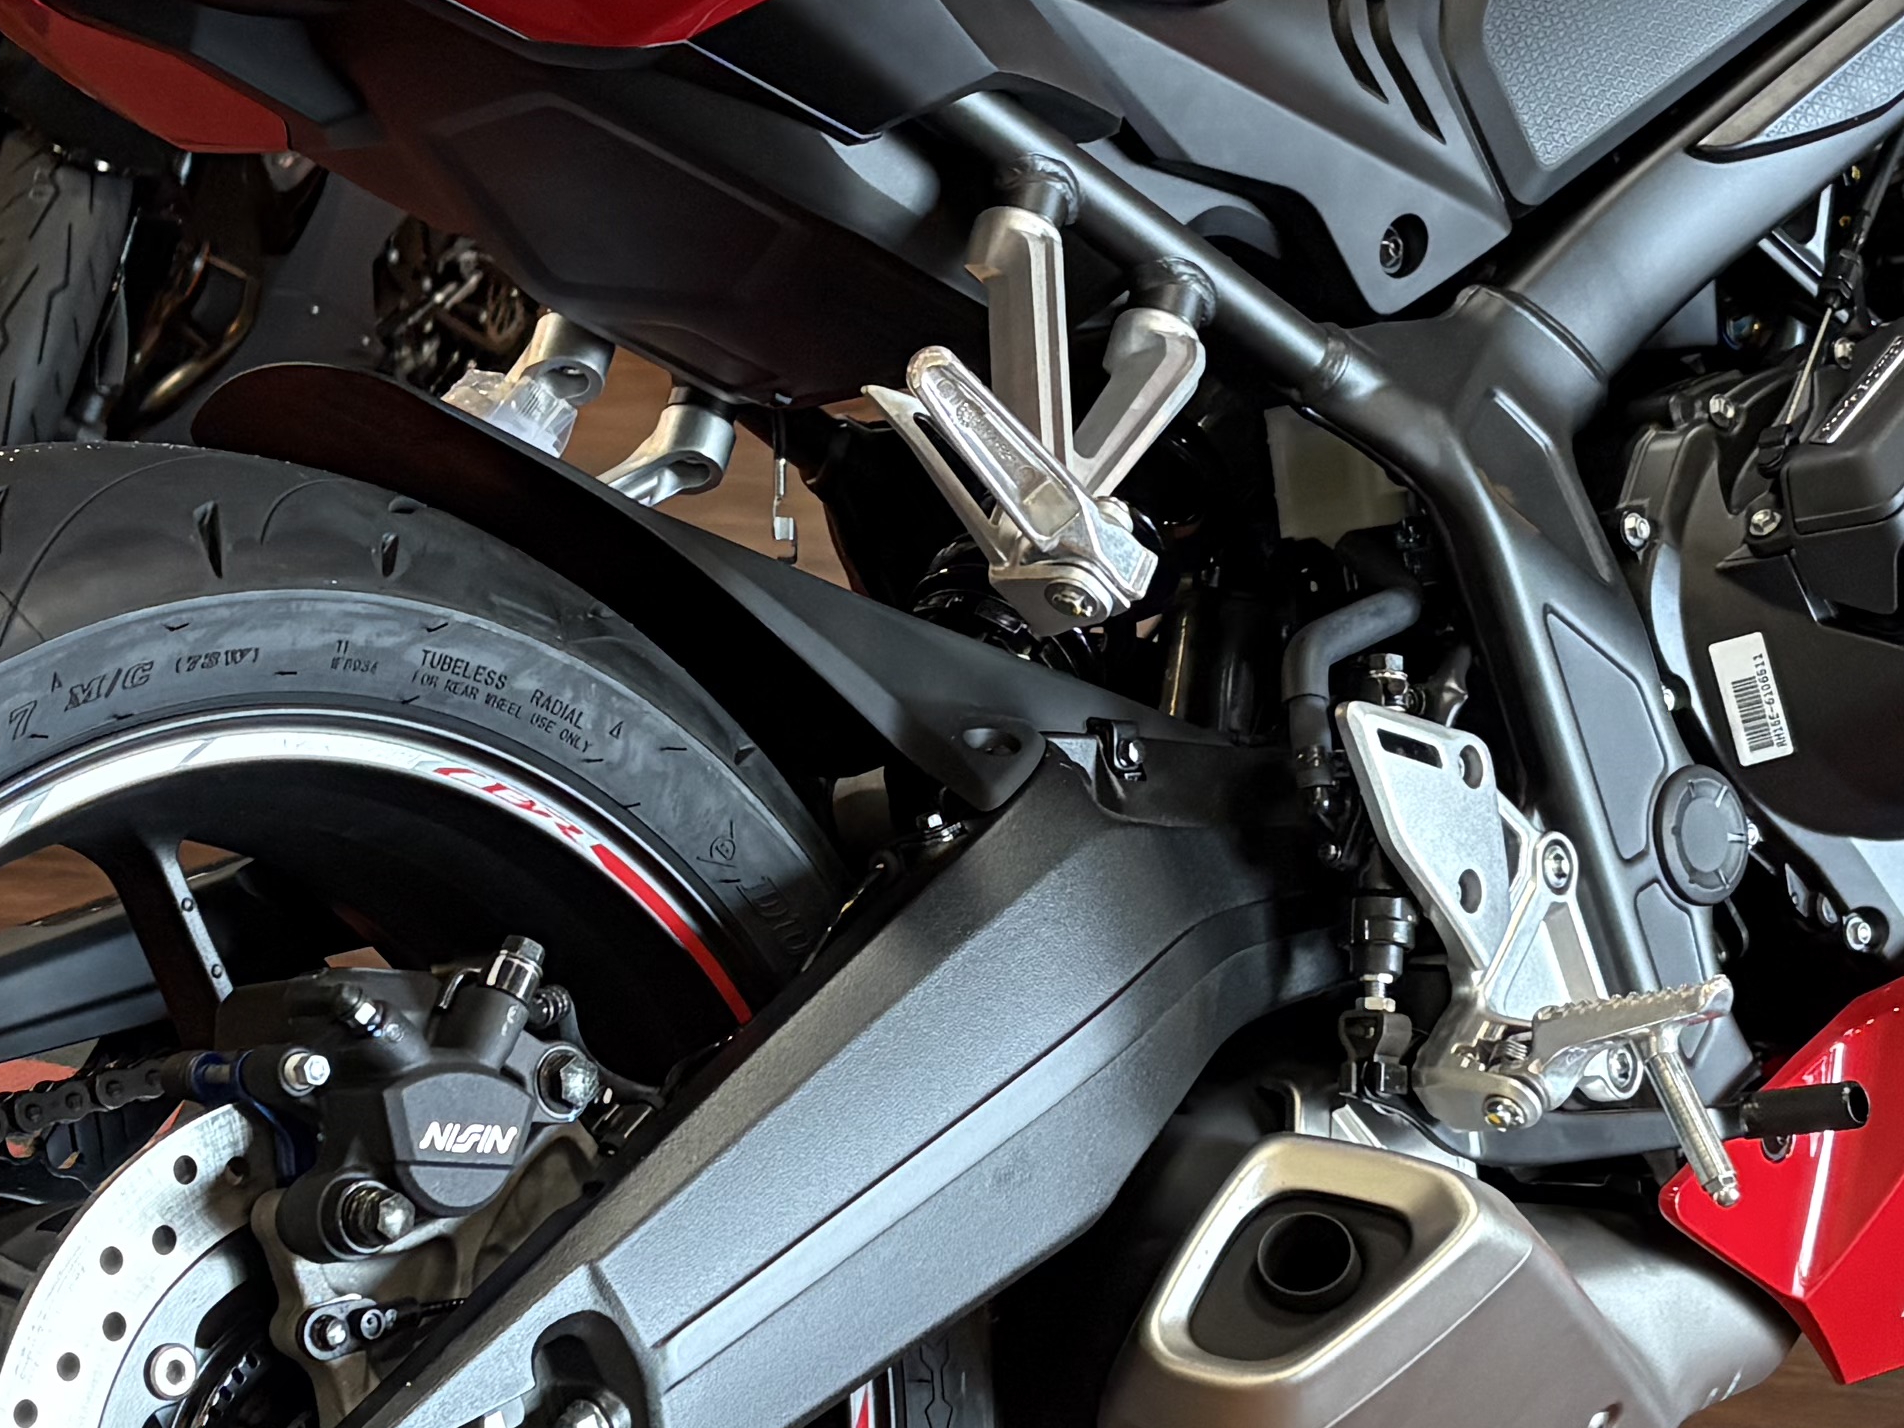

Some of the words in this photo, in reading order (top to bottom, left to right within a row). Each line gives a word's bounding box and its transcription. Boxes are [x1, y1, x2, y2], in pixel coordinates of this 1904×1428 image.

[63, 660, 154, 712] M/C
[421, 649, 508, 690] TUBELESS
[530, 689, 585, 731] RADIAL
[530, 712, 556, 734] USE
[559, 729, 593, 754] ONLY
